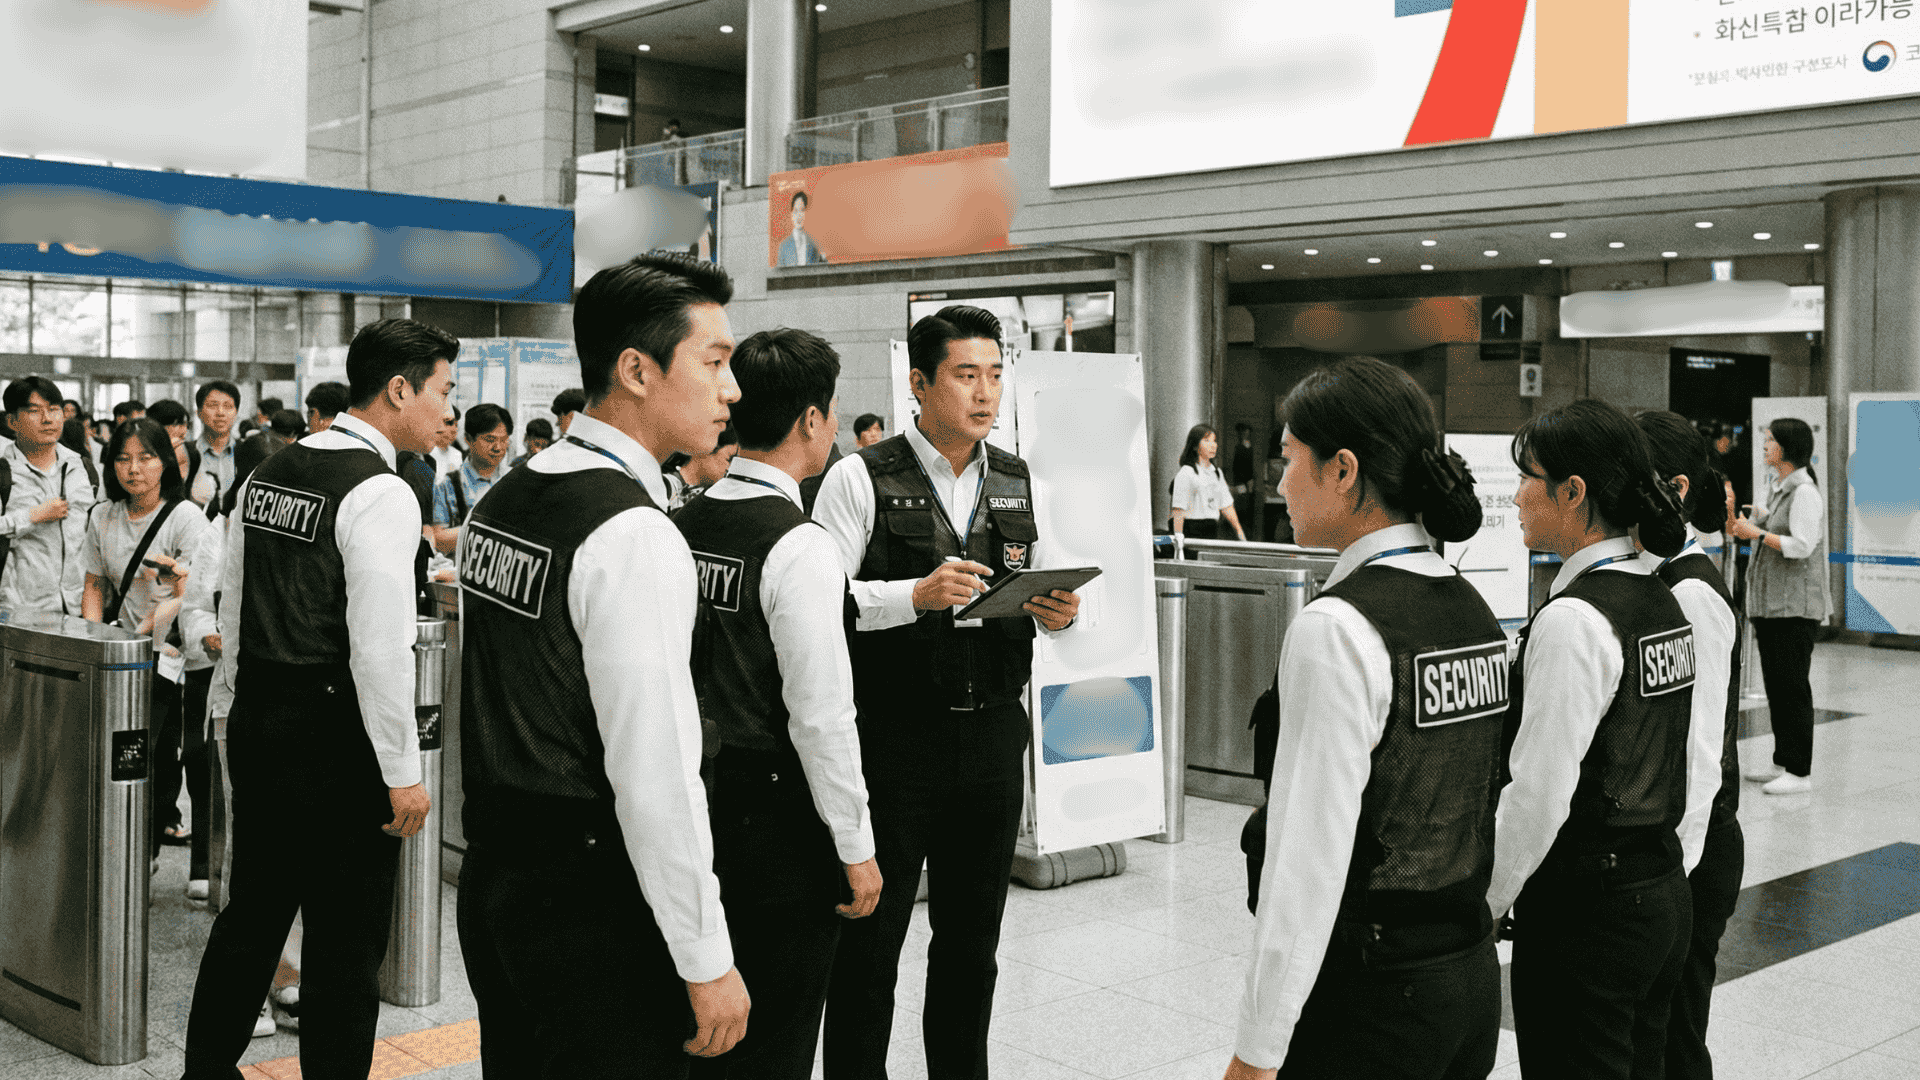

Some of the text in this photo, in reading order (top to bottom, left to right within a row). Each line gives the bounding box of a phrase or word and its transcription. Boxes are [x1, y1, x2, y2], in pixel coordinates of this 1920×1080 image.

[245, 487, 317, 533] SECURITY
[462, 531, 543, 604] SECURITY
[697, 559, 737, 603] RITY
[1645, 635, 1695, 688] SECURIT
